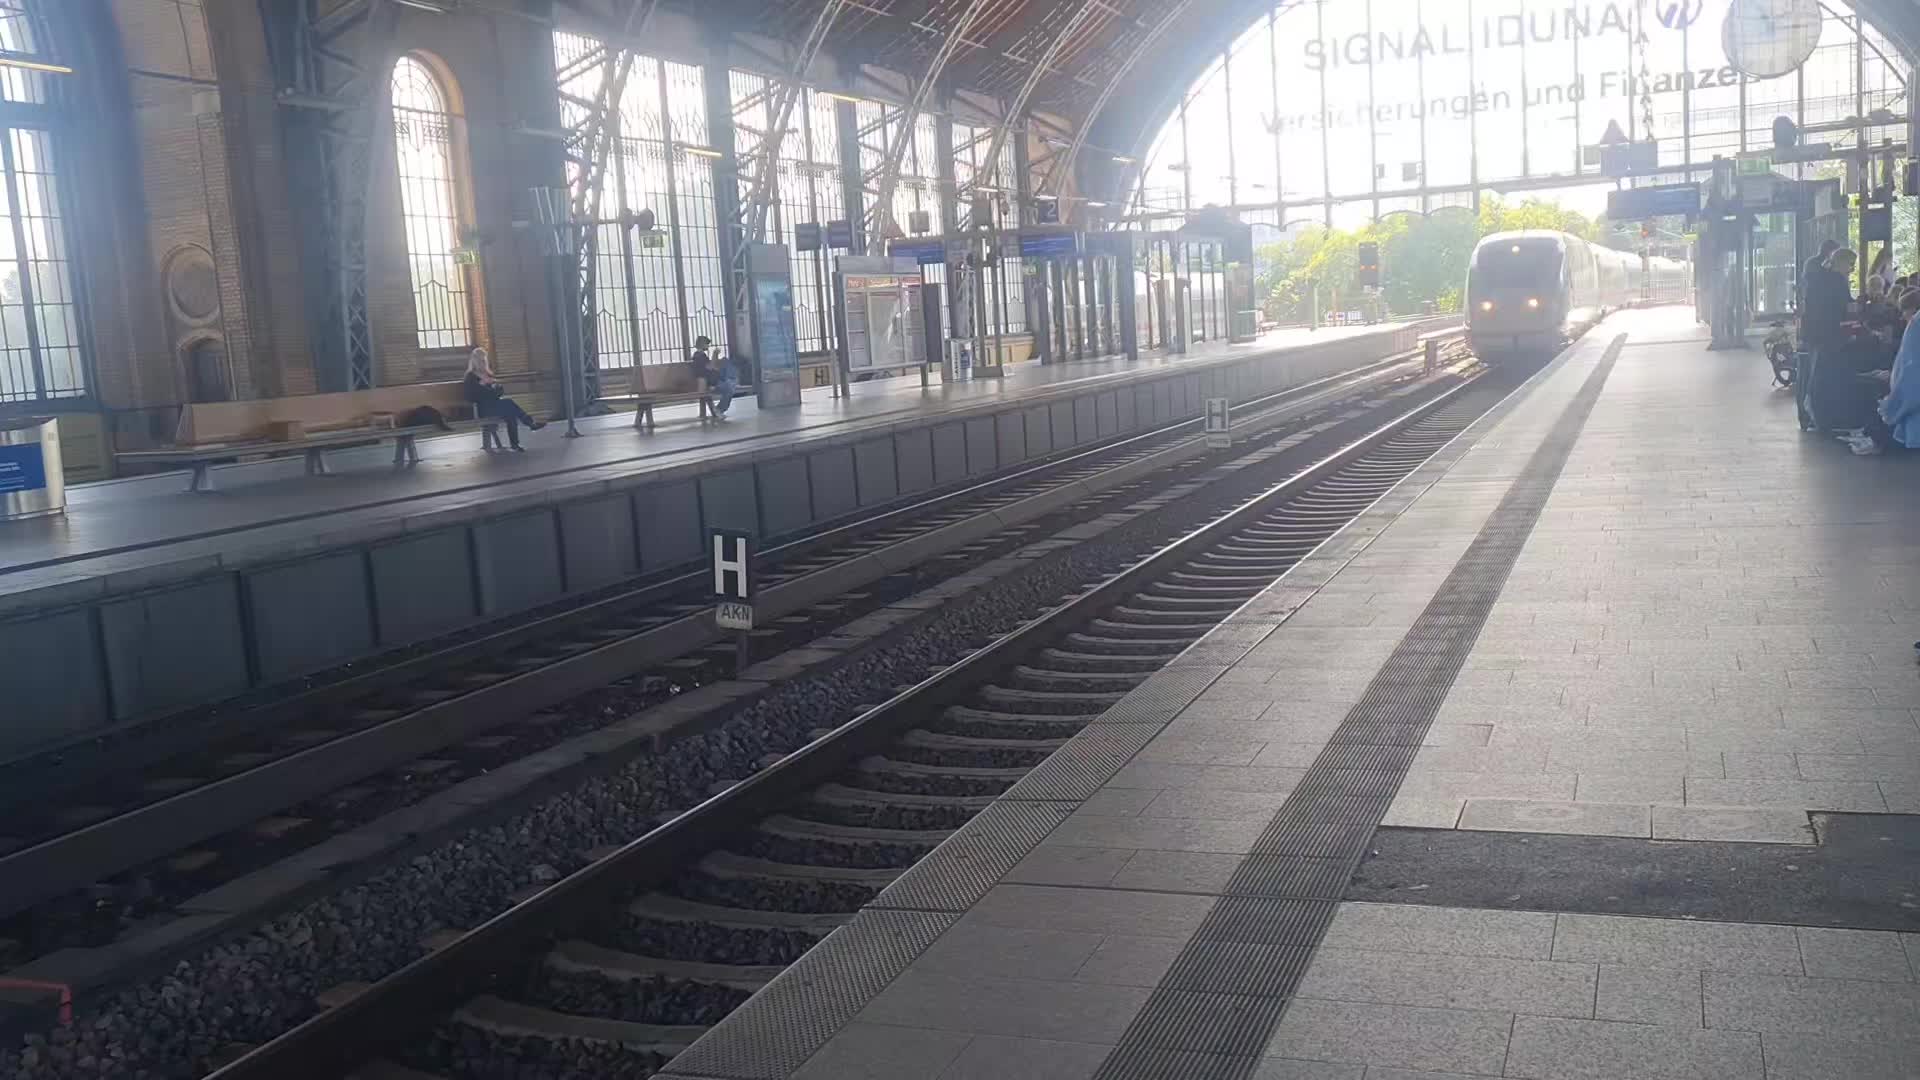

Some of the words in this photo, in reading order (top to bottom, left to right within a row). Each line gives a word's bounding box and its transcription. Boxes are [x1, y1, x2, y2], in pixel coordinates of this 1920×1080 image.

[1303, 24, 1465, 71] SIGNAL
[1483, 3, 1629, 48] IDUNA
[1523, 73, 1586, 107] und
[1599, 65, 1740, 97] Finanze
[1047, 201, 1057, 217] 2
[713, 534, 748, 598] H
[721, 604, 750, 621] AKN
